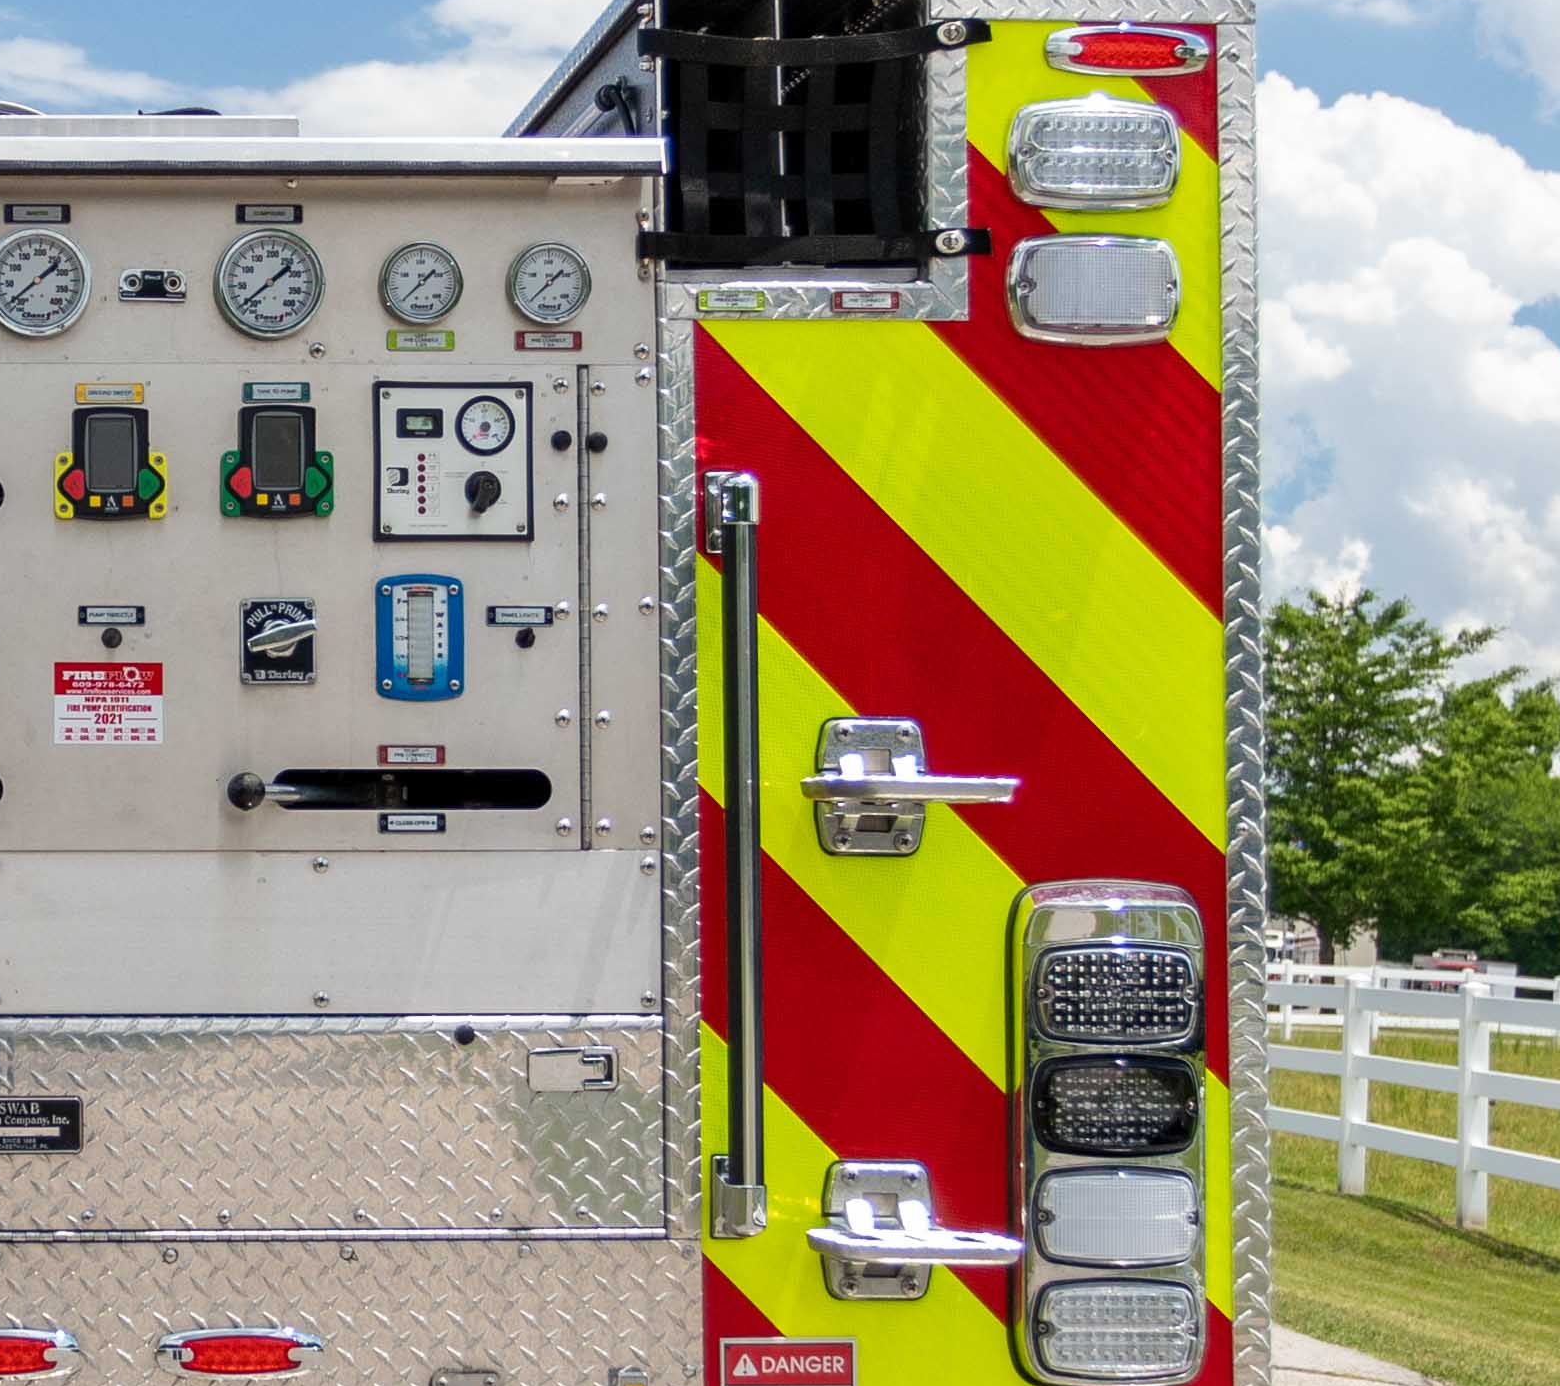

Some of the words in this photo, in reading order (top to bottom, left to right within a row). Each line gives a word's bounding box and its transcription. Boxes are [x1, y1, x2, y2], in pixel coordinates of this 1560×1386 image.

[48, 256, 61, 264] 250
[247, 605, 273, 628] PULL
[279, 603, 308, 622] PRIM
[435, 613, 444, 658] WATER
[267, 670, 304, 679] Darley
[95, 713, 122, 724] 2021
[0, 1103, 40, 1115] SWAB
[5, 1116, 49, 1126] Company,
[52, 1115, 70, 1125] Inc.
[762, 1356, 845, 1373] DANGER
